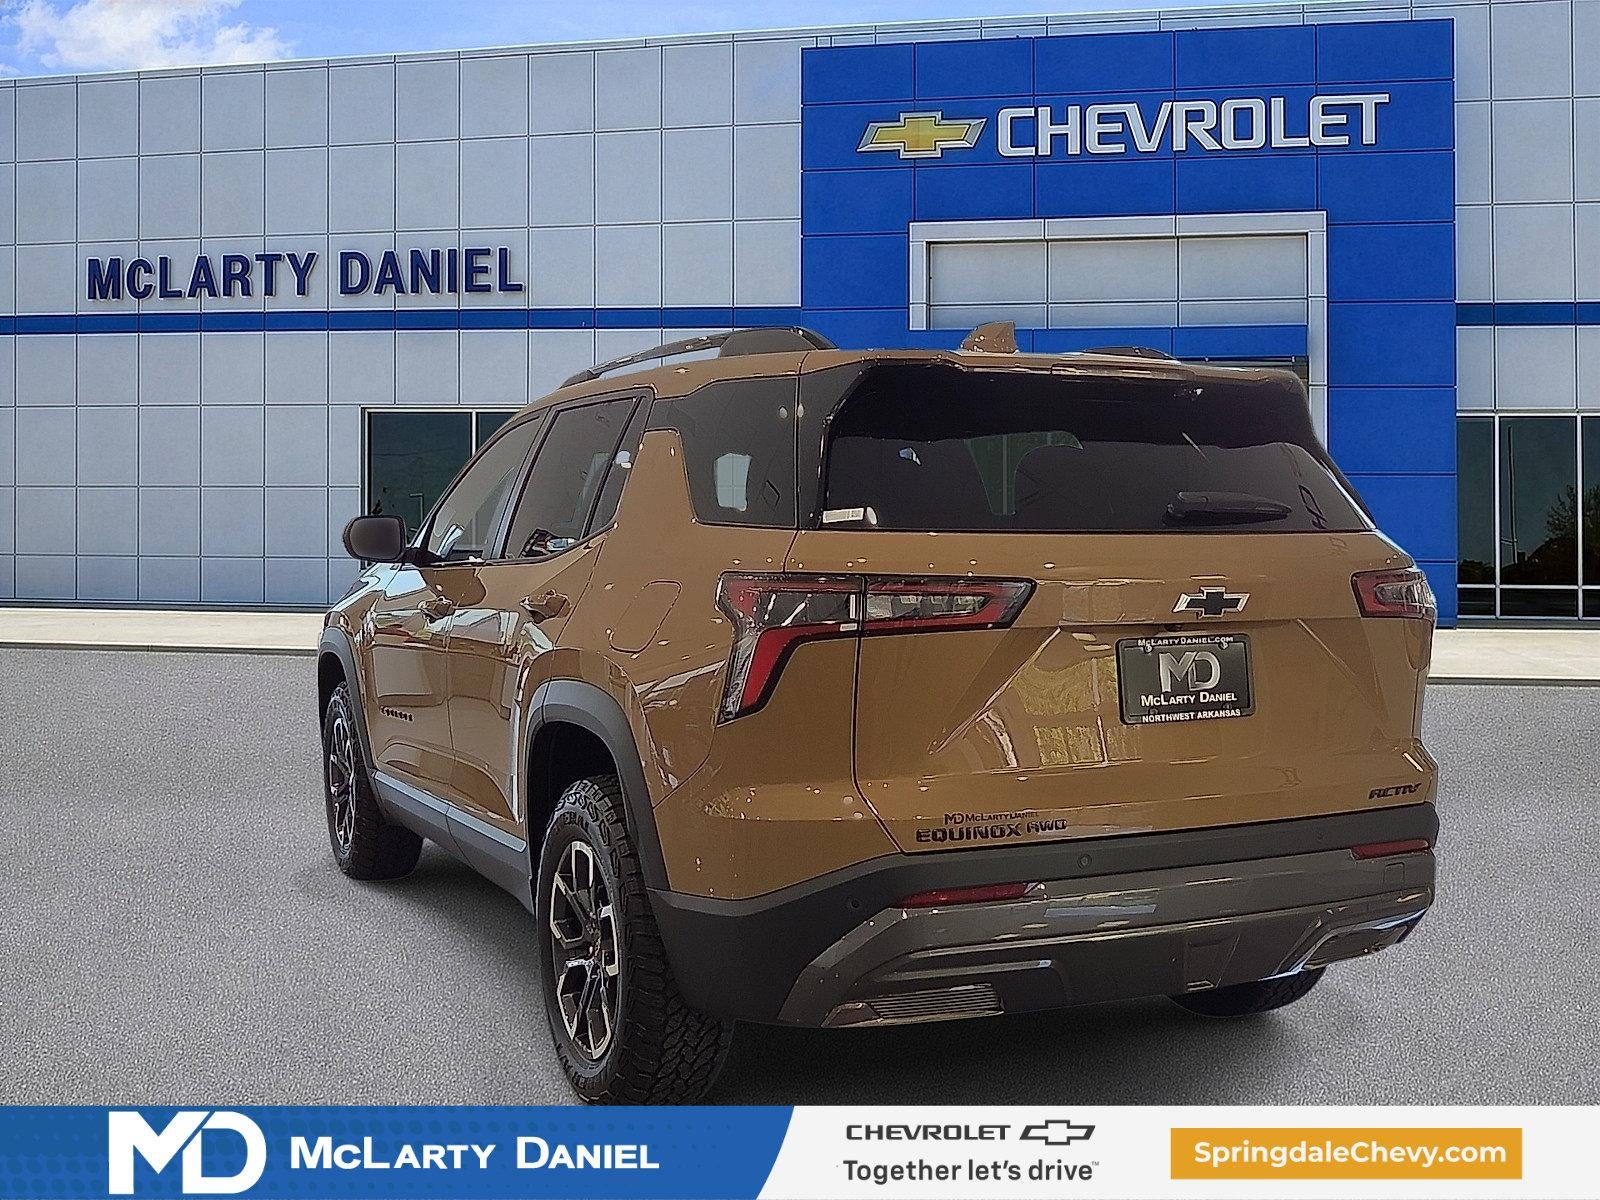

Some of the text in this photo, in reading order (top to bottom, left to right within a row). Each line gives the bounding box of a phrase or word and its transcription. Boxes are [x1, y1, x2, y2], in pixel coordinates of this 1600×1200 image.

[997, 94, 1390, 156] CHEVROLET
[339, 247, 525, 296] DANIEL
[1142, 708, 1241, 723] NORTHWEST ARKANSAS
[916, 818, 1068, 843] EQUINOX AWD
